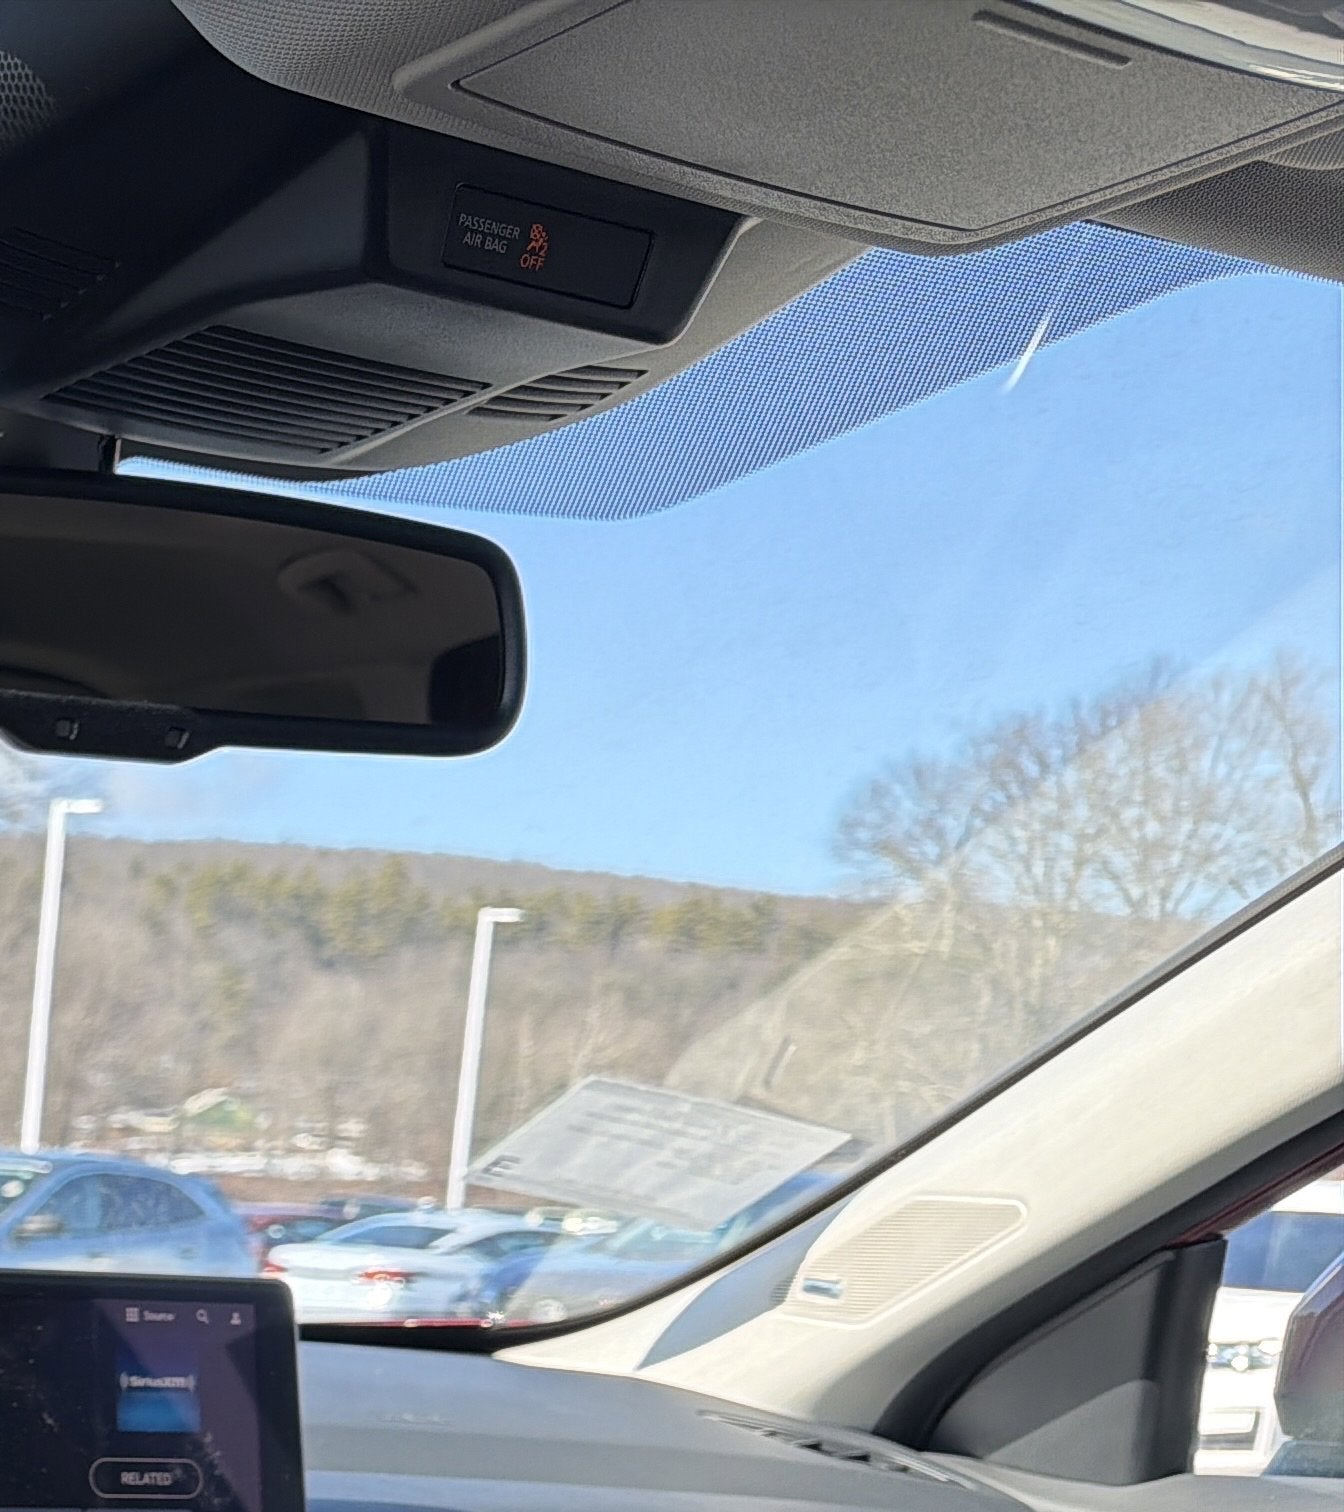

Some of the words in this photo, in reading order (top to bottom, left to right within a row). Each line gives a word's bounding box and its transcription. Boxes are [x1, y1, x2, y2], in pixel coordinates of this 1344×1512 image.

[458, 213, 520, 240] PASSENGER
[463, 232, 481, 248] AIR
[485, 238, 508, 254] BAG
[520, 254, 545, 271] OFF
[120, 1471, 172, 1486] RELATED
